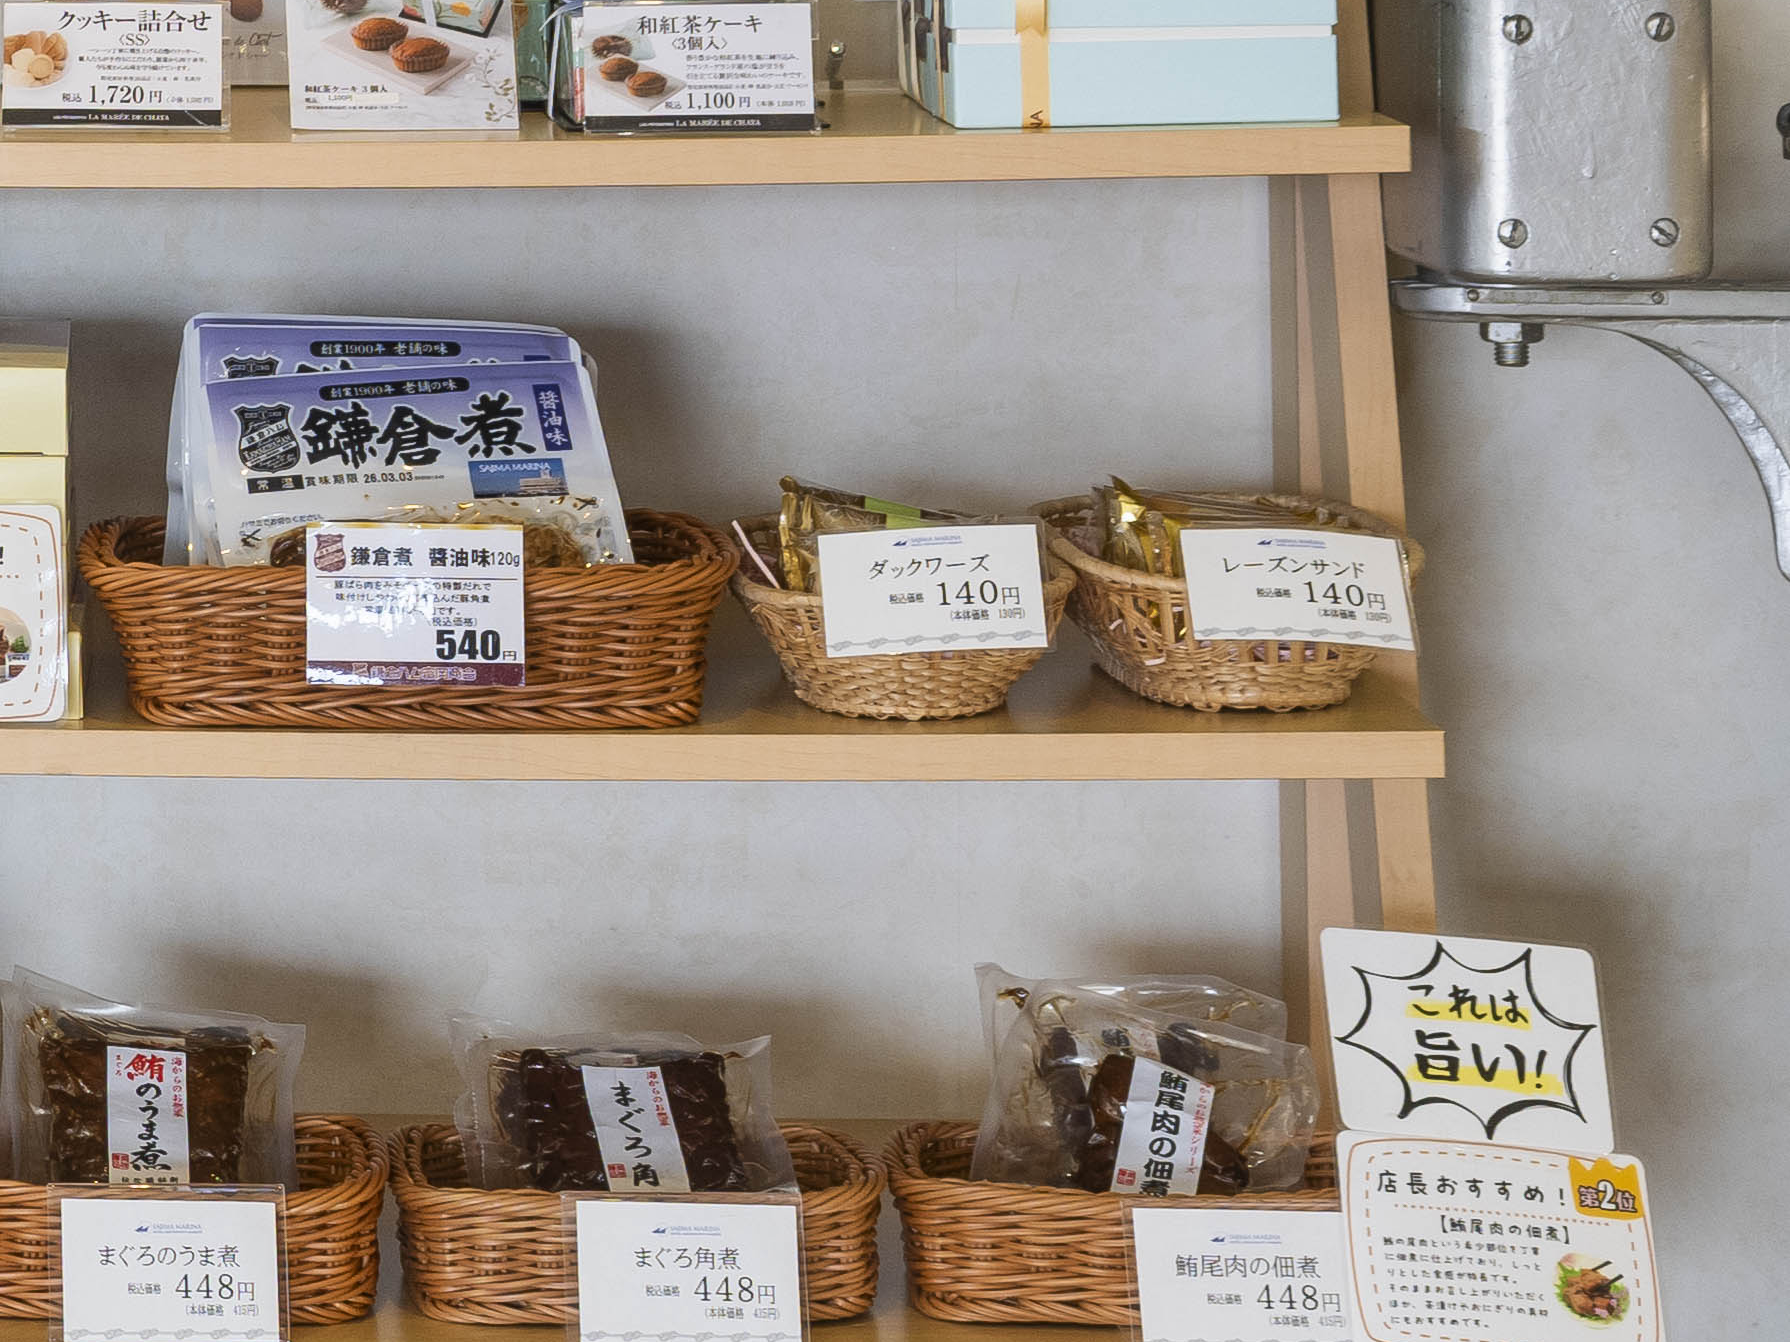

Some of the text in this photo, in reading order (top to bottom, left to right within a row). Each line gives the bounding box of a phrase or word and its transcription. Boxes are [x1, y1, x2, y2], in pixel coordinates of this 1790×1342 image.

[58, 9, 212, 33] クッキー詰合せ
[637, 15, 763, 35] 和紅茶ケーキ
[62, 92, 82, 103] 税込
[330, 378, 458, 399] 創業1900年 老舗の味
[301, 391, 537, 469] 鎌倉煮
[305, 470, 413, 488] 賞味期限 26.03.03
[478, 461, 552, 473] SAJIMA MARINA
[350, 546, 413, 567] 鎌倉煮
[869, 554, 991, 582] ダックワーズ
[1222, 556, 1365, 582] レーズンサンド
[937, 579, 1021, 607] 140円
[1303, 580, 1386, 611] 140円
[1407, 984, 1530, 1025] これは
[124, 1052, 172, 1172] 鮪のうま煮
[610, 1081, 661, 1187] まぐろ角
[1139, 1069, 1190, 1197] 鮪尾肉の佃煮
[98, 1245, 240, 1268] まぐろのうま煮
[634, 1247, 742, 1270] まぐろ角煮
[1176, 1254, 1321, 1279] 鮪尾肉の佃煮
[175, 1273, 255, 1301] 448円
[694, 1276, 776, 1304] 448円
[1256, 1284, 1340, 1312] 448円
